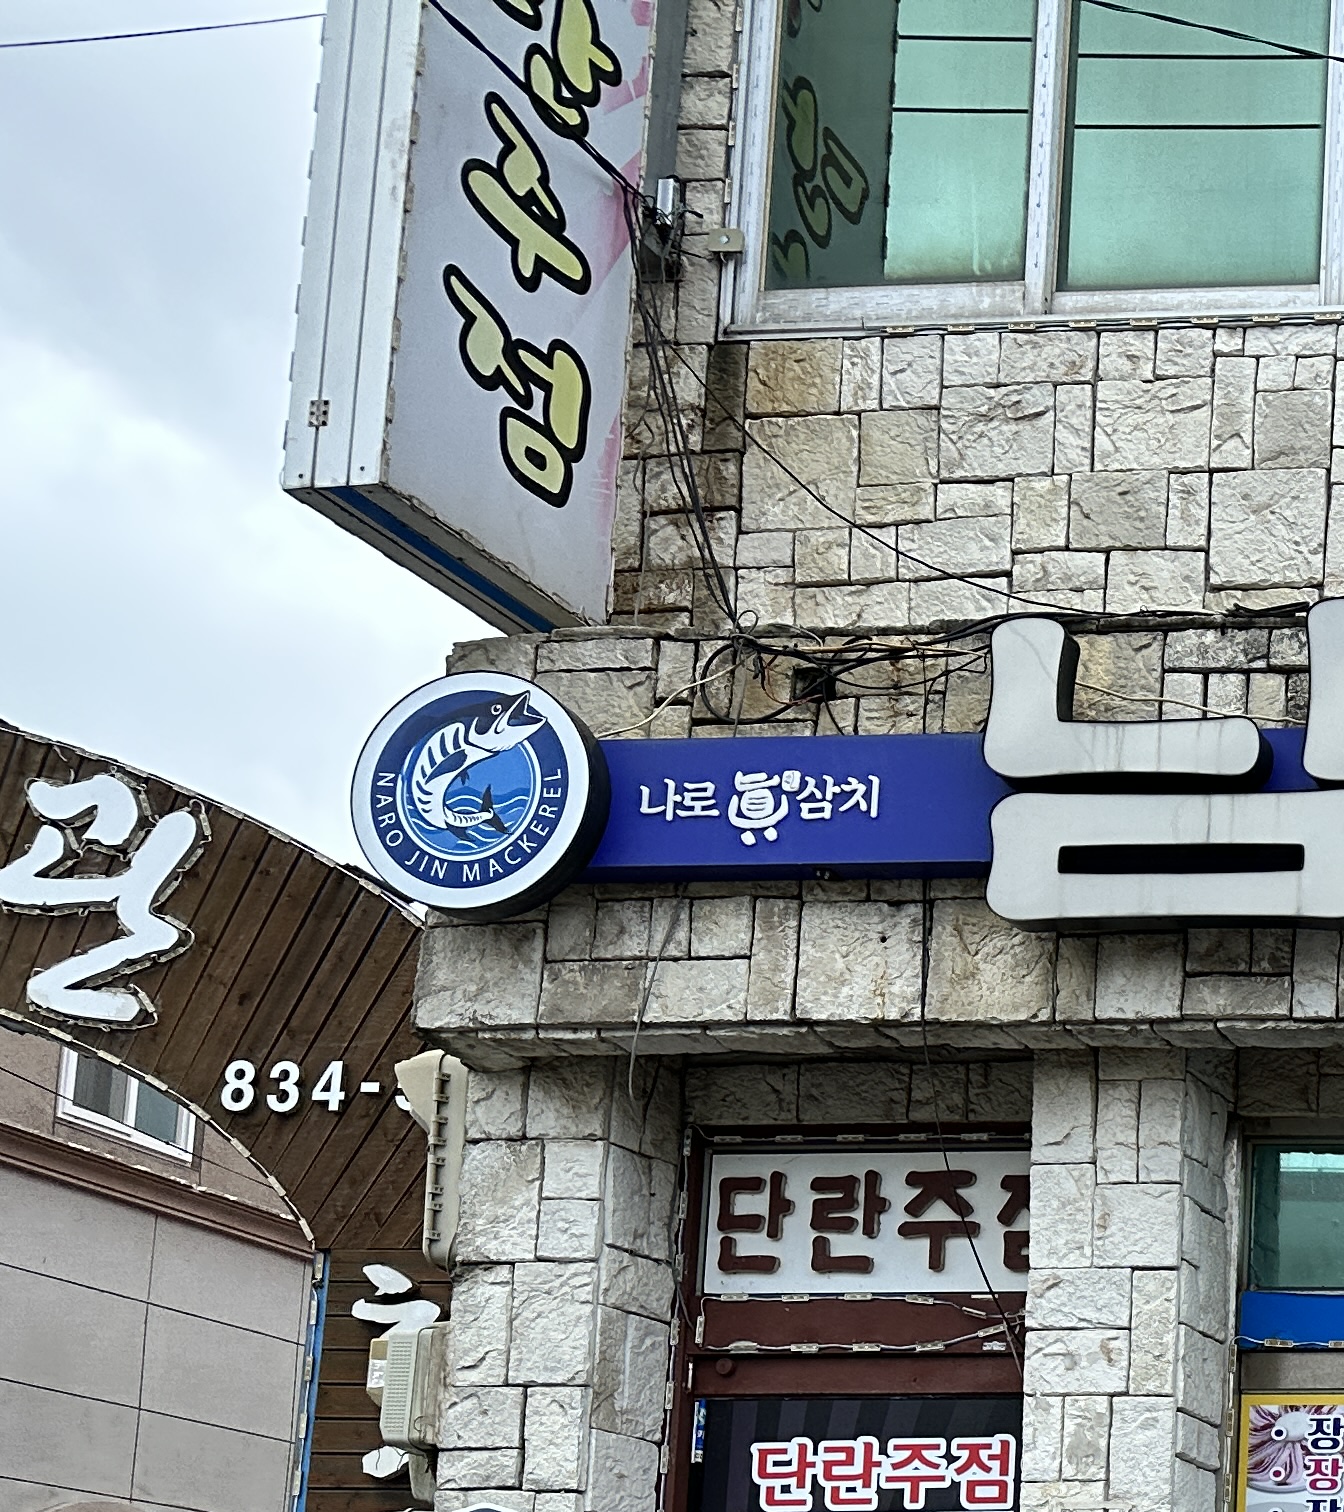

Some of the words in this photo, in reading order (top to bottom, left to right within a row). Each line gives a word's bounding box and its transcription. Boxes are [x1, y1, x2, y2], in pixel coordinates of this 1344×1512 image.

[376, 772, 403, 848] NARO
[404, 851, 448, 880] JIN
[462, 768, 562, 882] MACKEREL
[220, 1060, 412, 1113] 834-
[751, 1435, 1016, 1512] 단란주점
